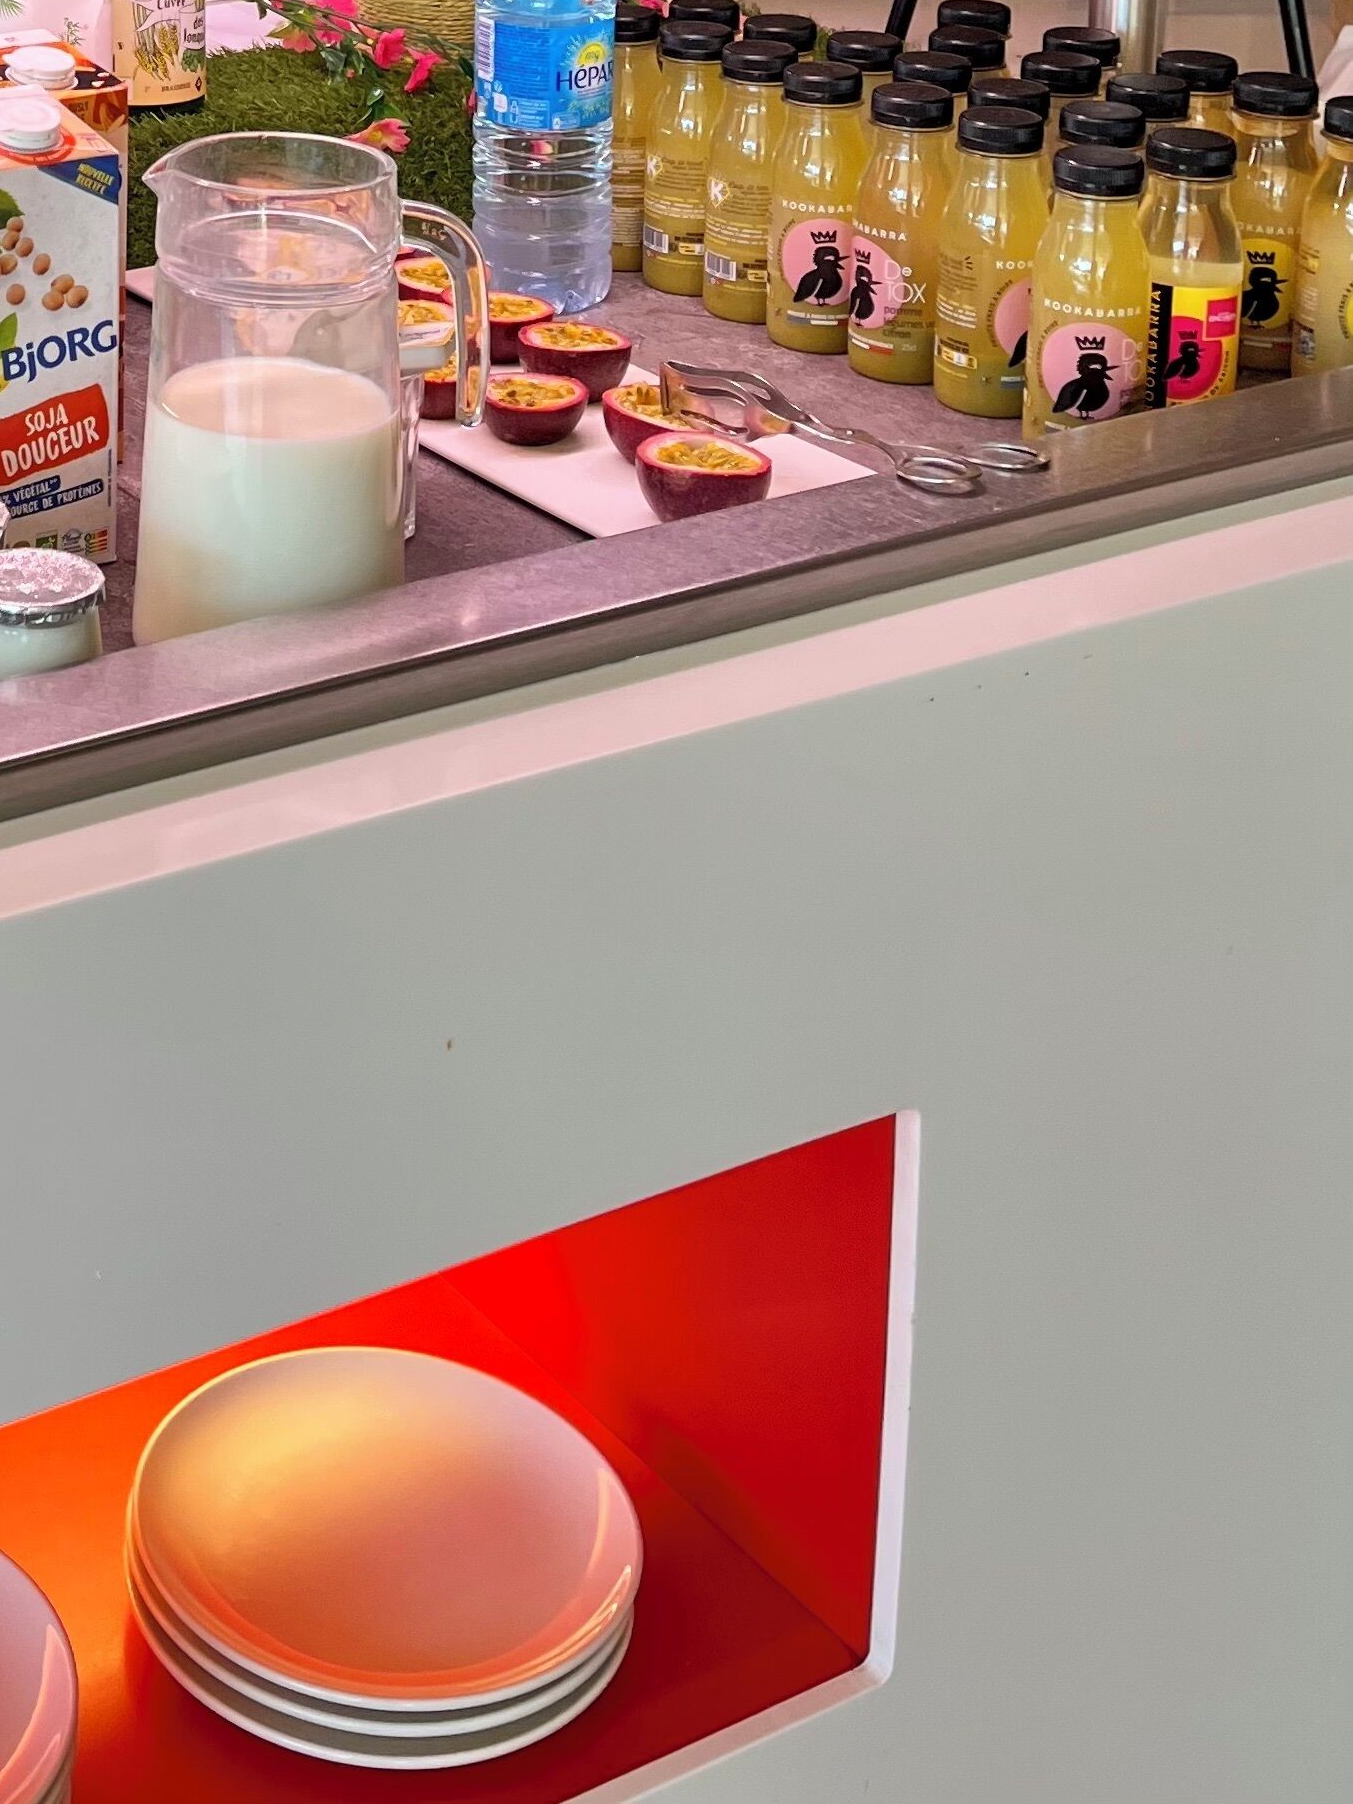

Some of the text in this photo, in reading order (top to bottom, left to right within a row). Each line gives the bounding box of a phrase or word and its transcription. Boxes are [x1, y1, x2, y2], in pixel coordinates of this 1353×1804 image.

[885, 259, 913, 281] De
[888, 282, 927, 304] TOX
[1043, 297, 1142, 318] KOOKABARRA
[24, 403, 69, 437] SOJA
[0, 415, 101, 478] DOUCEUR
